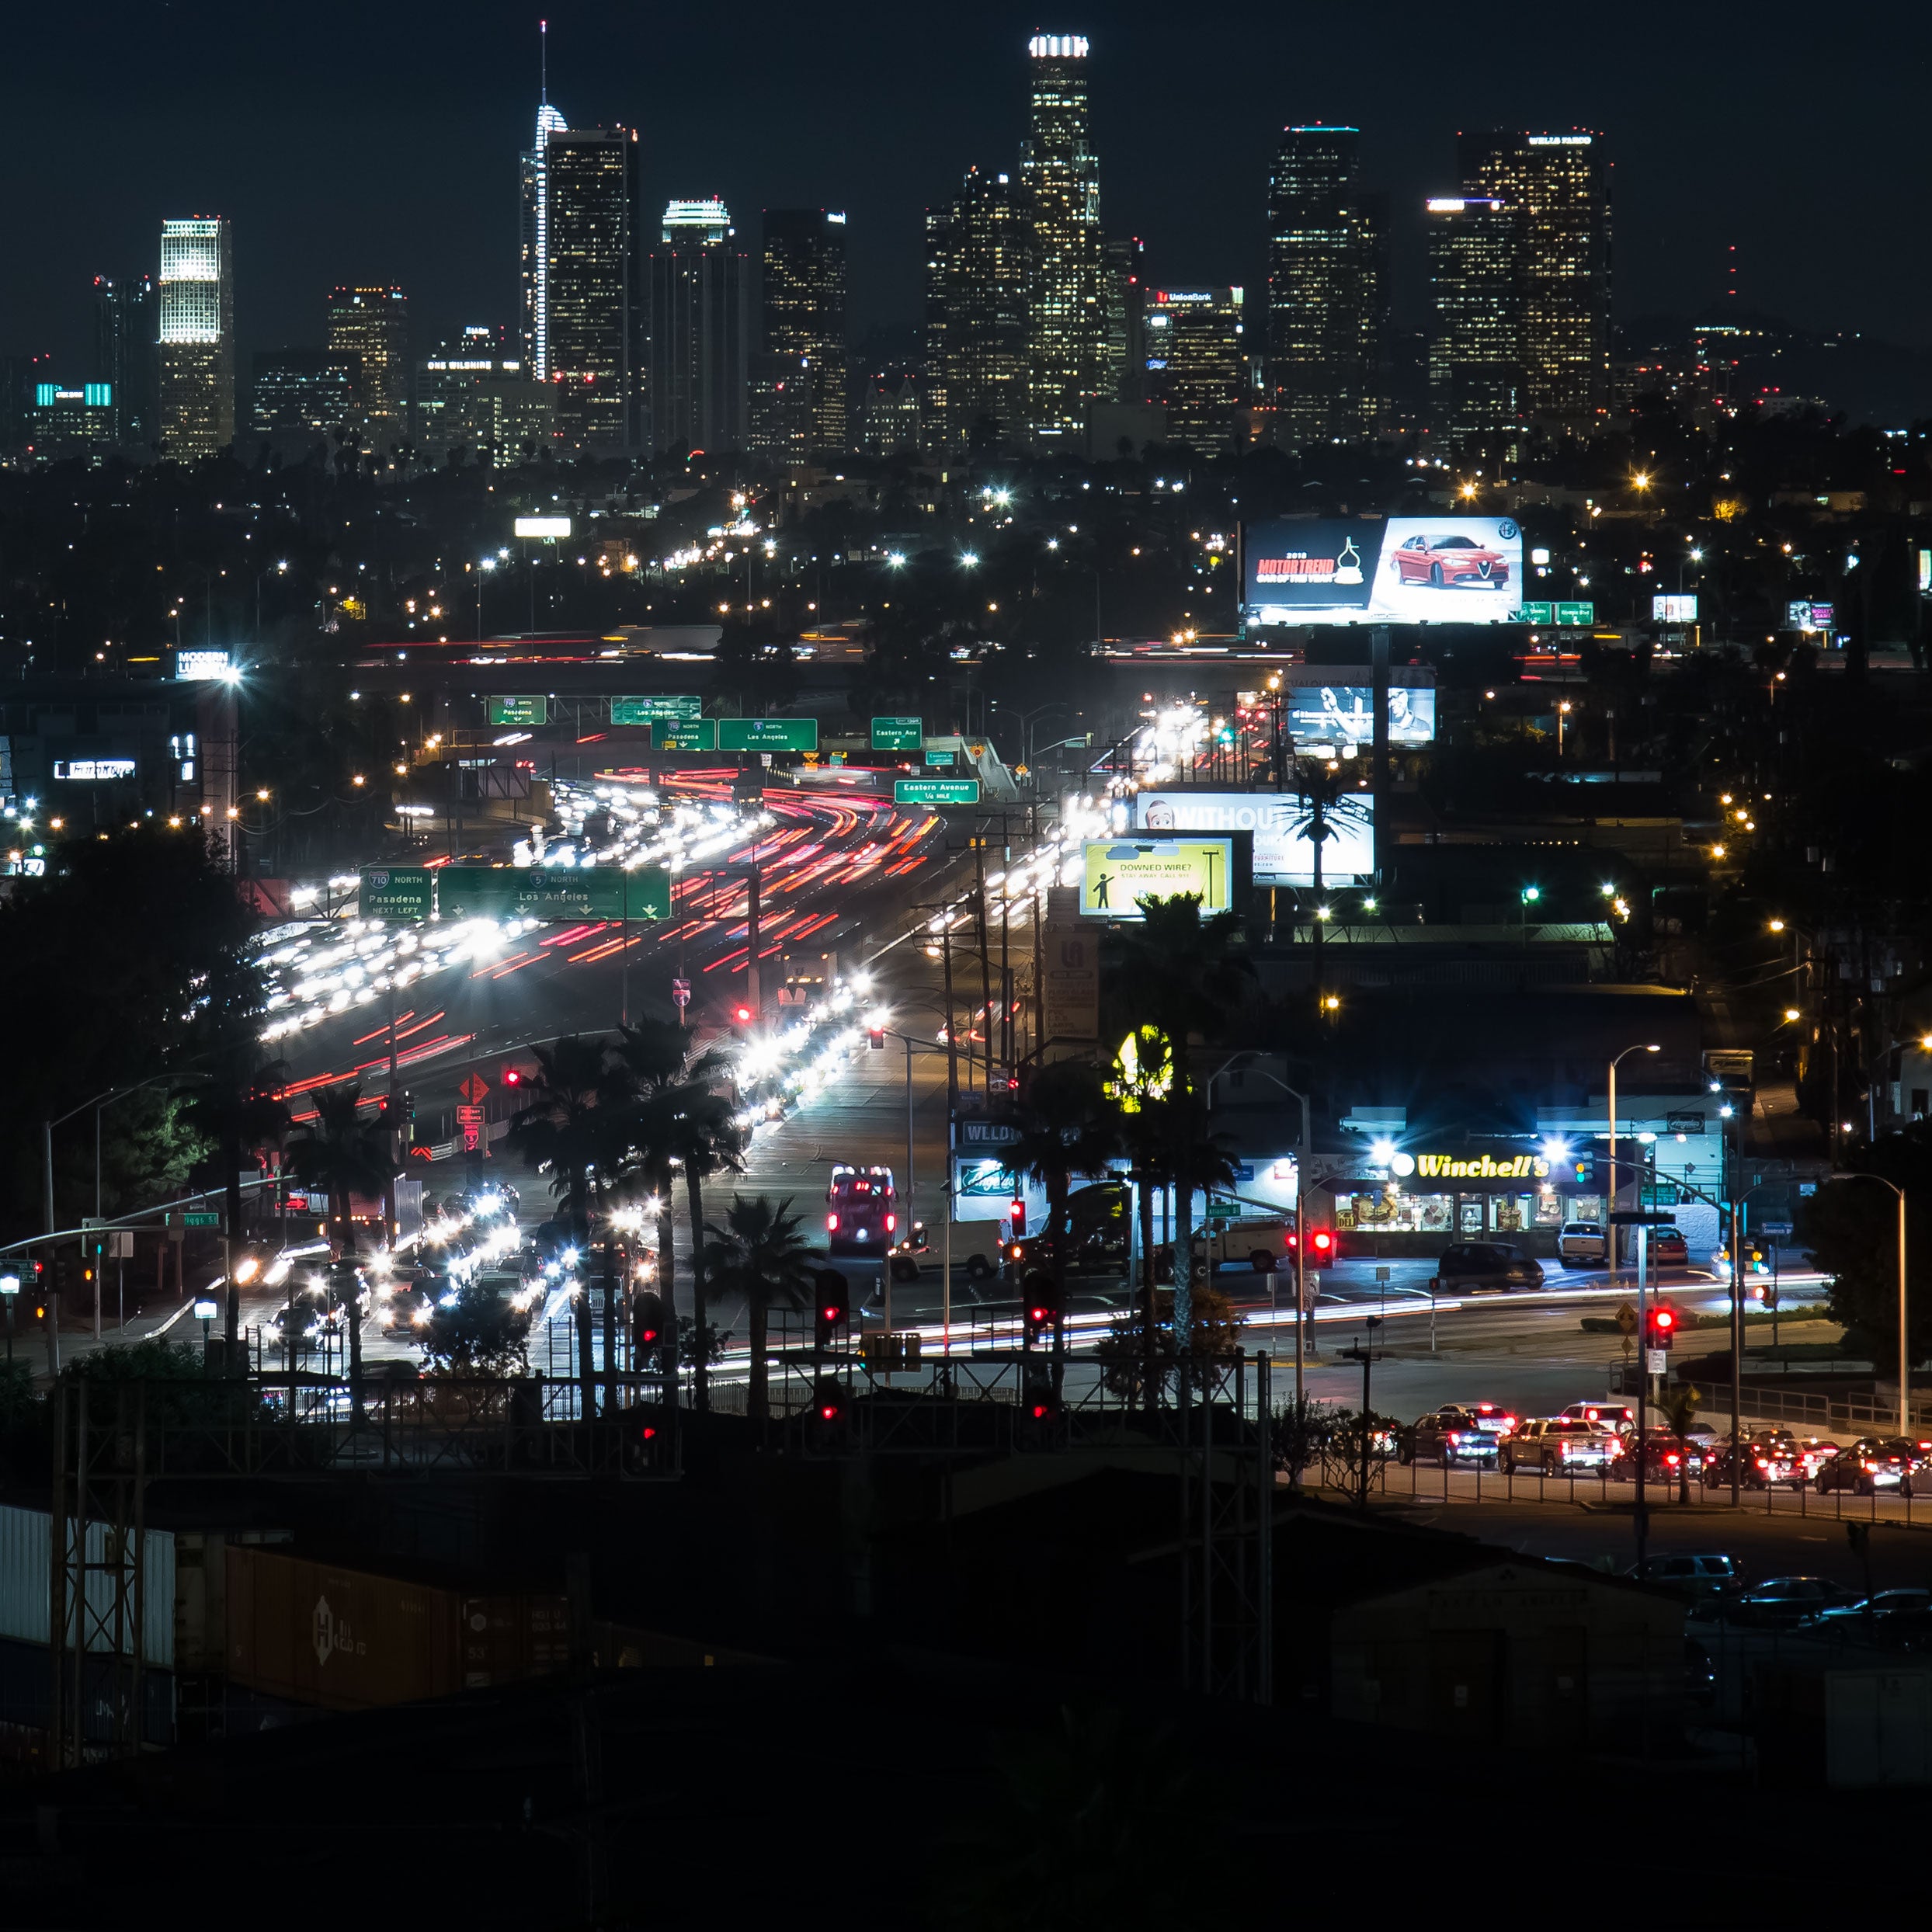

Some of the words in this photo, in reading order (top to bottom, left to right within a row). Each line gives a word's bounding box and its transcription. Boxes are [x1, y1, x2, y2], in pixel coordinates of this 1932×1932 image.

[178, 652, 228, 662] MODERN
[371, 876, 387, 884] 710
[535, 876, 541, 884] 5
[369, 895, 422, 903] Pasadena
[519, 892, 538, 901] Los
[545, 892, 589, 903] Angeles
[1417, 1155, 1550, 1177] Winchell's
